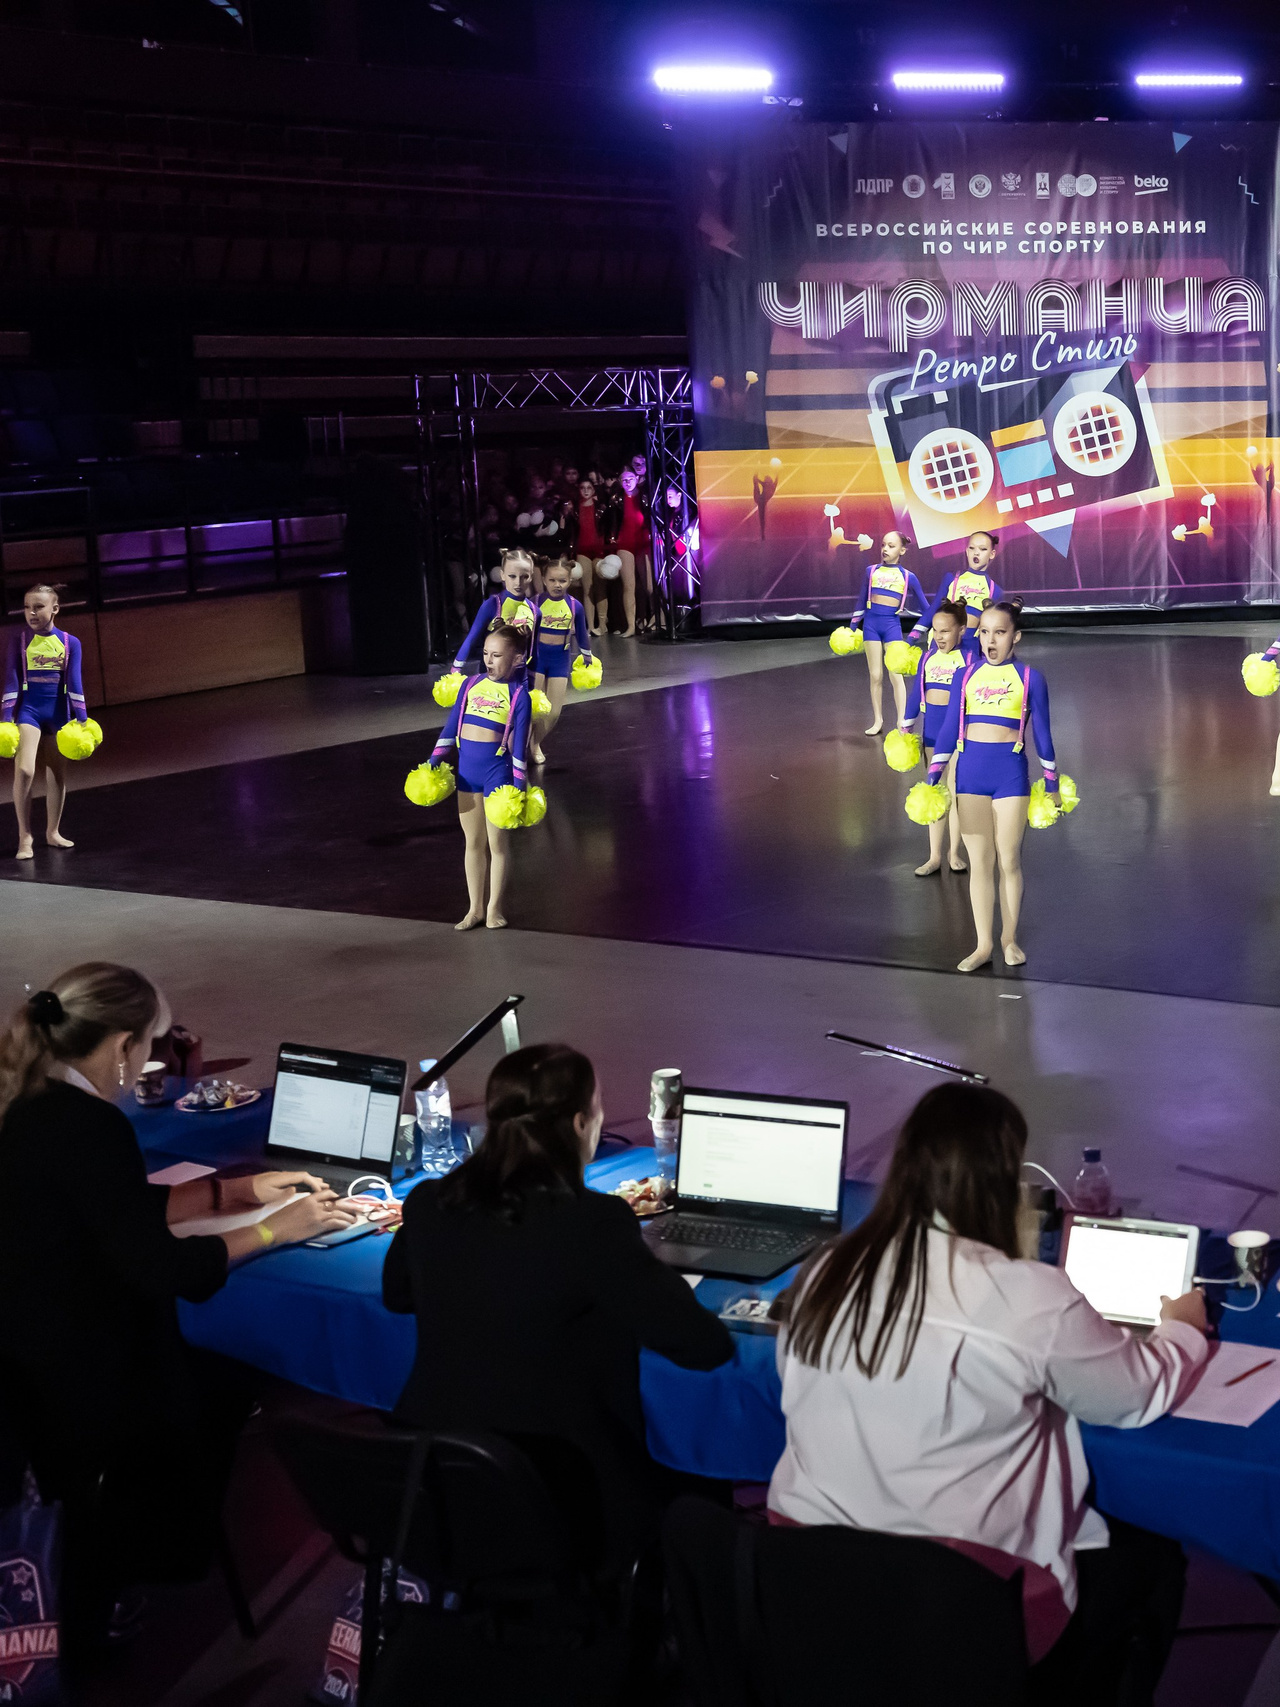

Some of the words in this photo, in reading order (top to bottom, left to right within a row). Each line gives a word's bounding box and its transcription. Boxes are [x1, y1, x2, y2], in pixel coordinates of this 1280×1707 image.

[855, 178, 894, 195] ЛДПР
[1134, 174, 1169, 188] beko
[816, 219, 1014, 237] ВСЕРОССИЙСКИЕ
[1024, 219, 1207, 236] СОРЕВНОВАНИЯ
[922, 240, 953, 255] ПО
[963, 240, 1007, 255] ЧИР
[1018, 239, 1106, 255] СПОРТУ
[910, 347, 1017, 391] Ретро
[1031, 331, 1138, 365] Стиль
